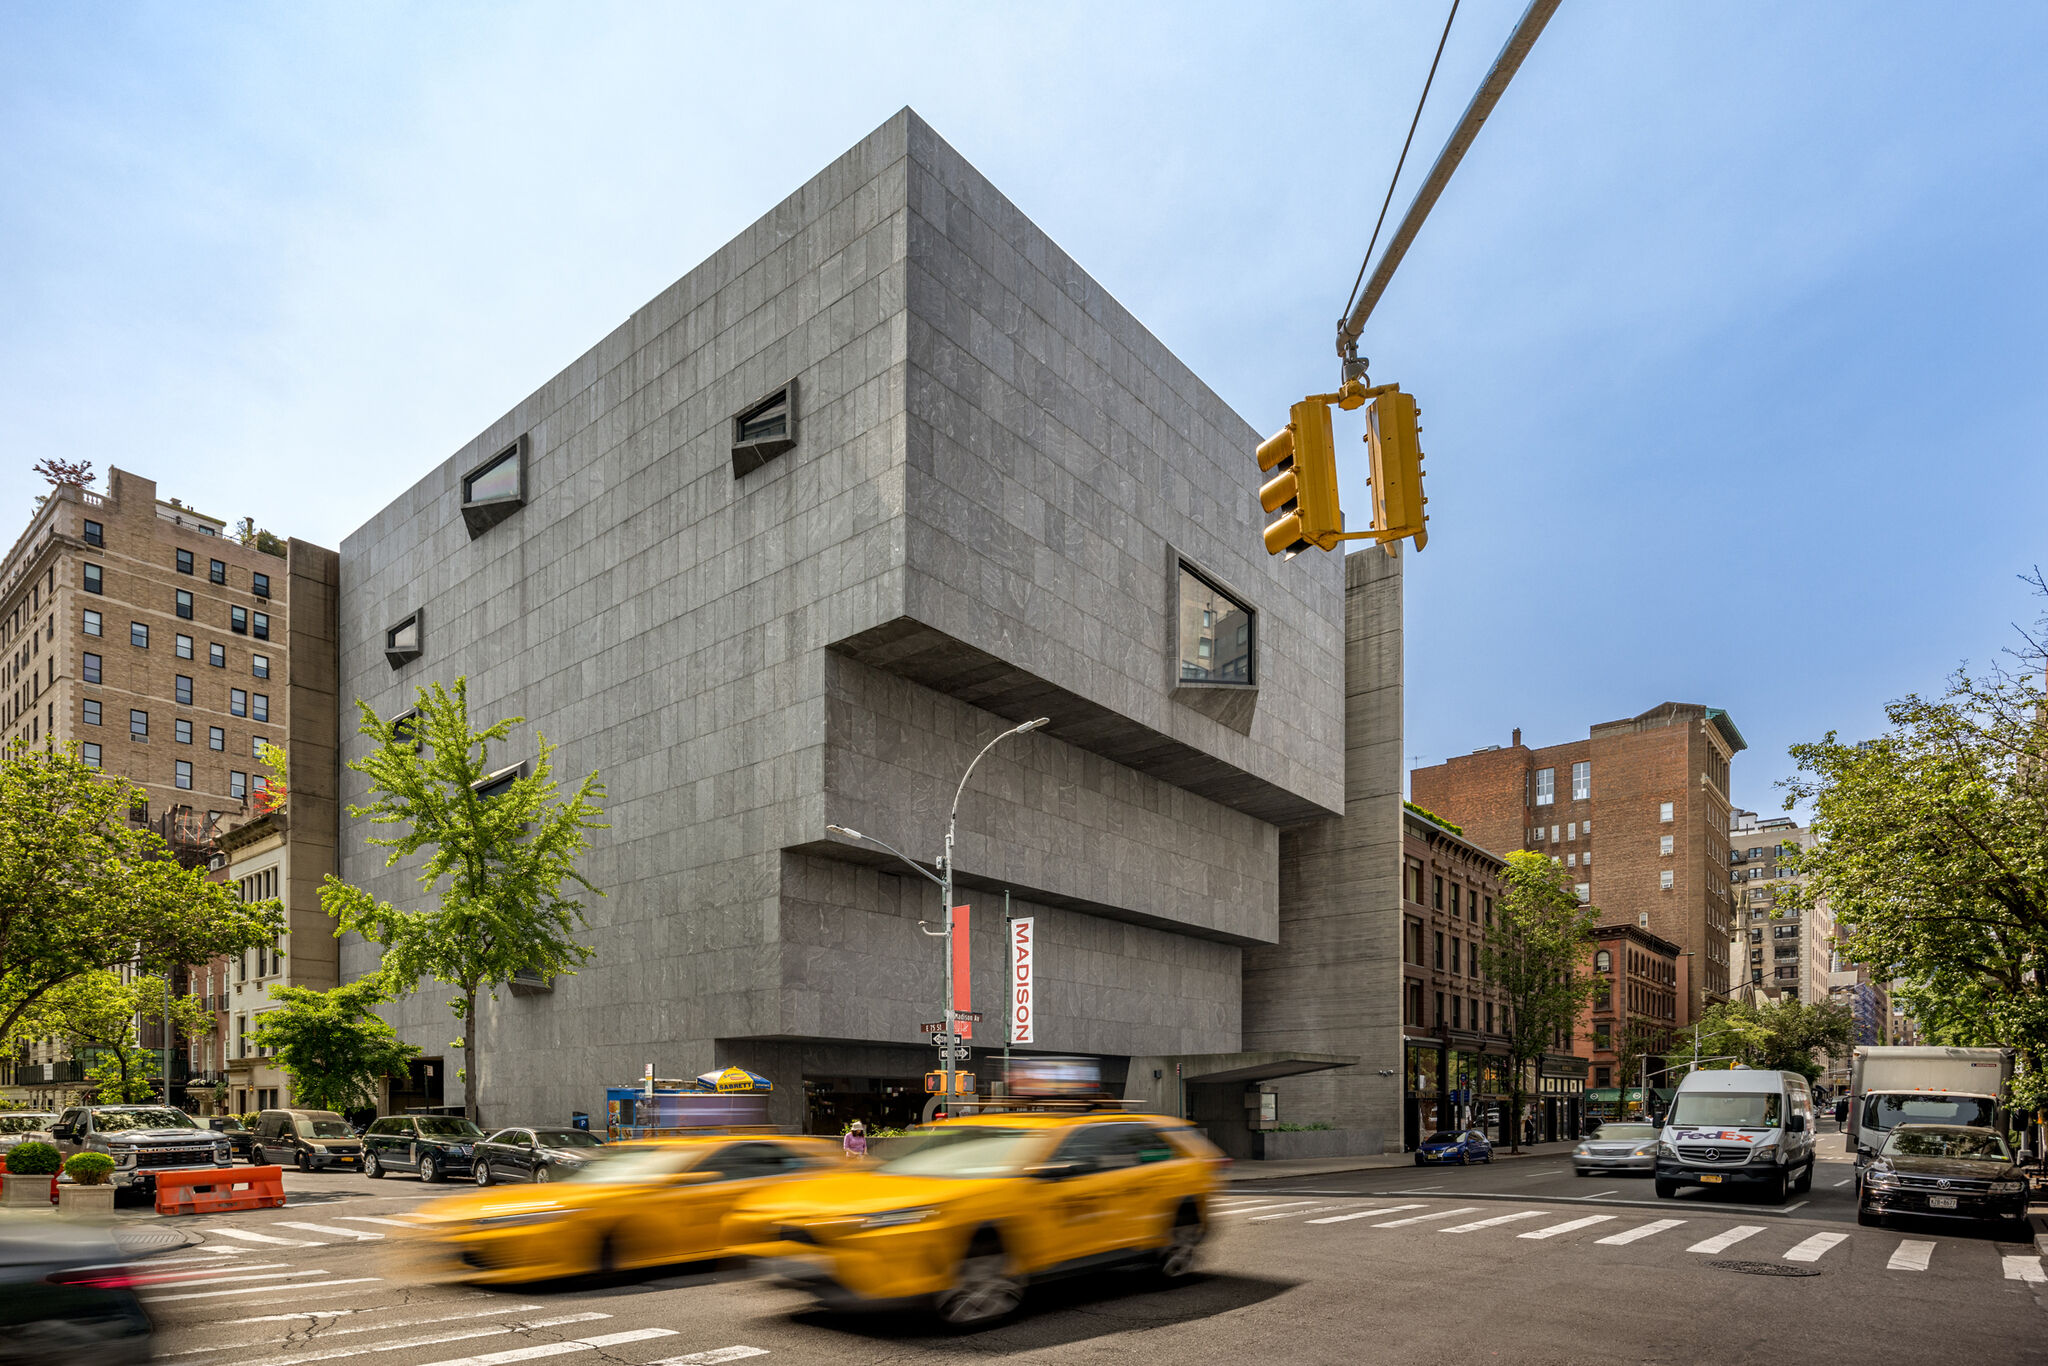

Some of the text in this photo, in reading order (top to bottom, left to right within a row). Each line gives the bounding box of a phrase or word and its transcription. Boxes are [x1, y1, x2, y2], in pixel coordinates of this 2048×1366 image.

[1016, 923, 1029, 1041] MADISON
[954, 1013, 973, 1021] Madison
[1676, 1130, 1755, 1143] FedEx
